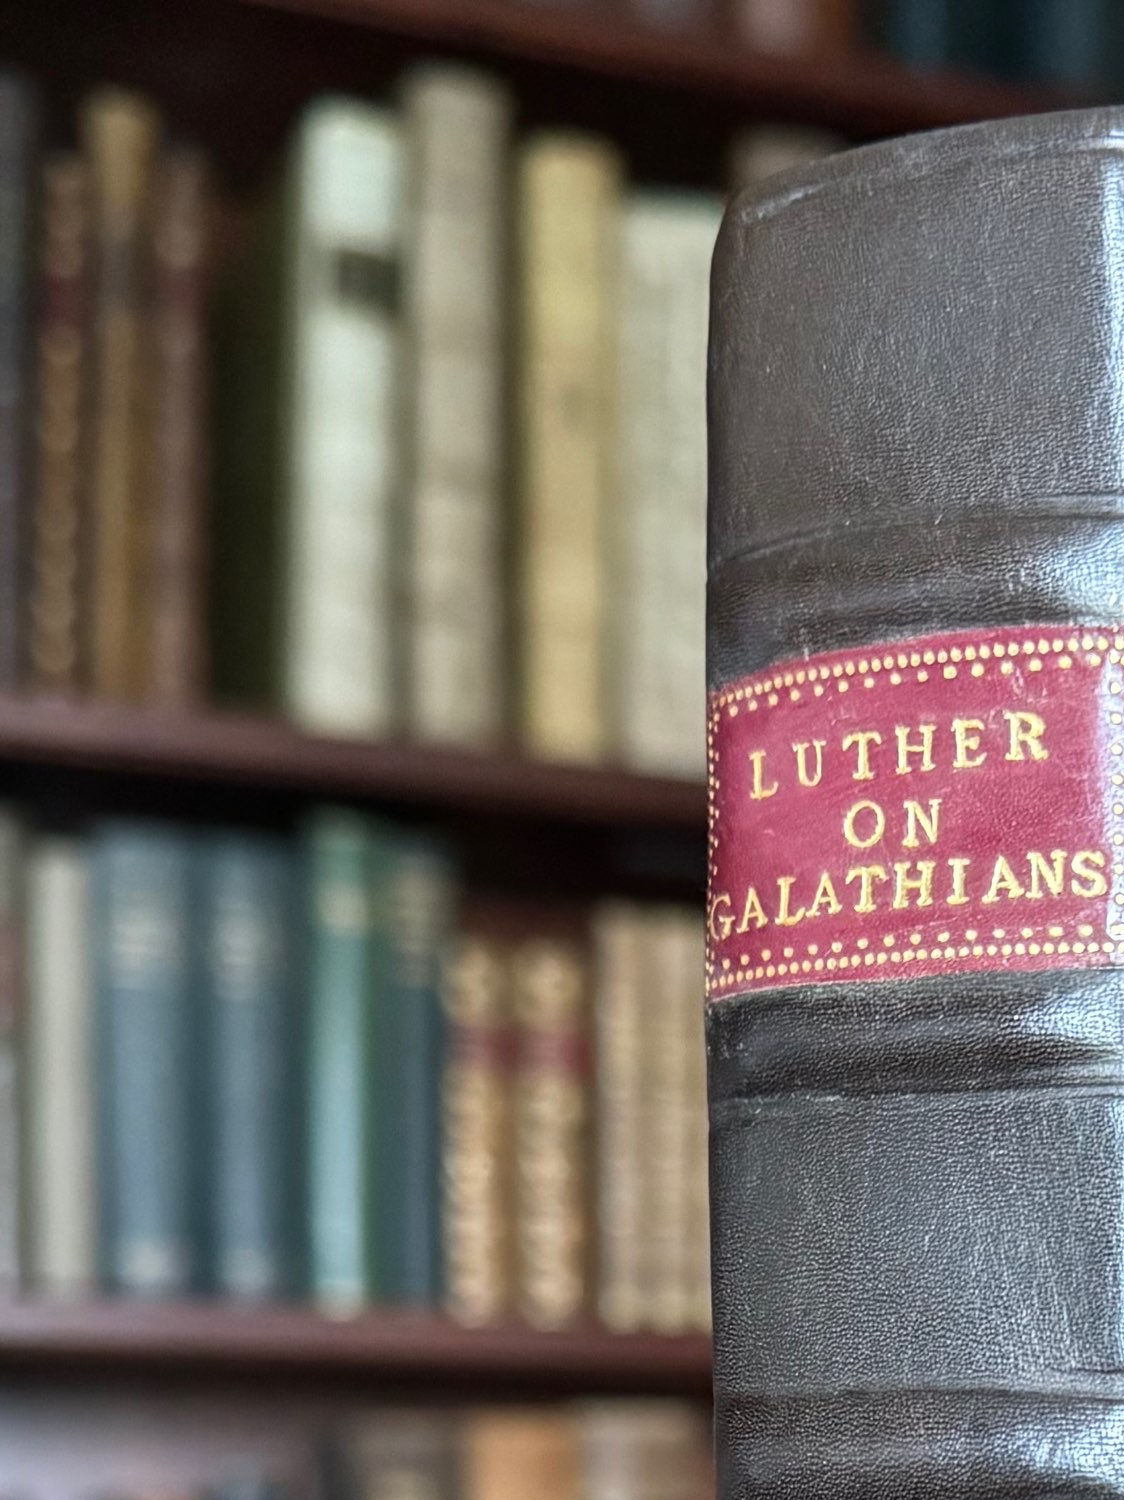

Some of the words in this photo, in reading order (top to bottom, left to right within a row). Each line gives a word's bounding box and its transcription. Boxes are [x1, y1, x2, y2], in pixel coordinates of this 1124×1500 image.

[749, 711, 1049, 800] LUTHER
[843, 799, 942, 848] ON
[709, 850, 1108, 941] GALATHIANS
